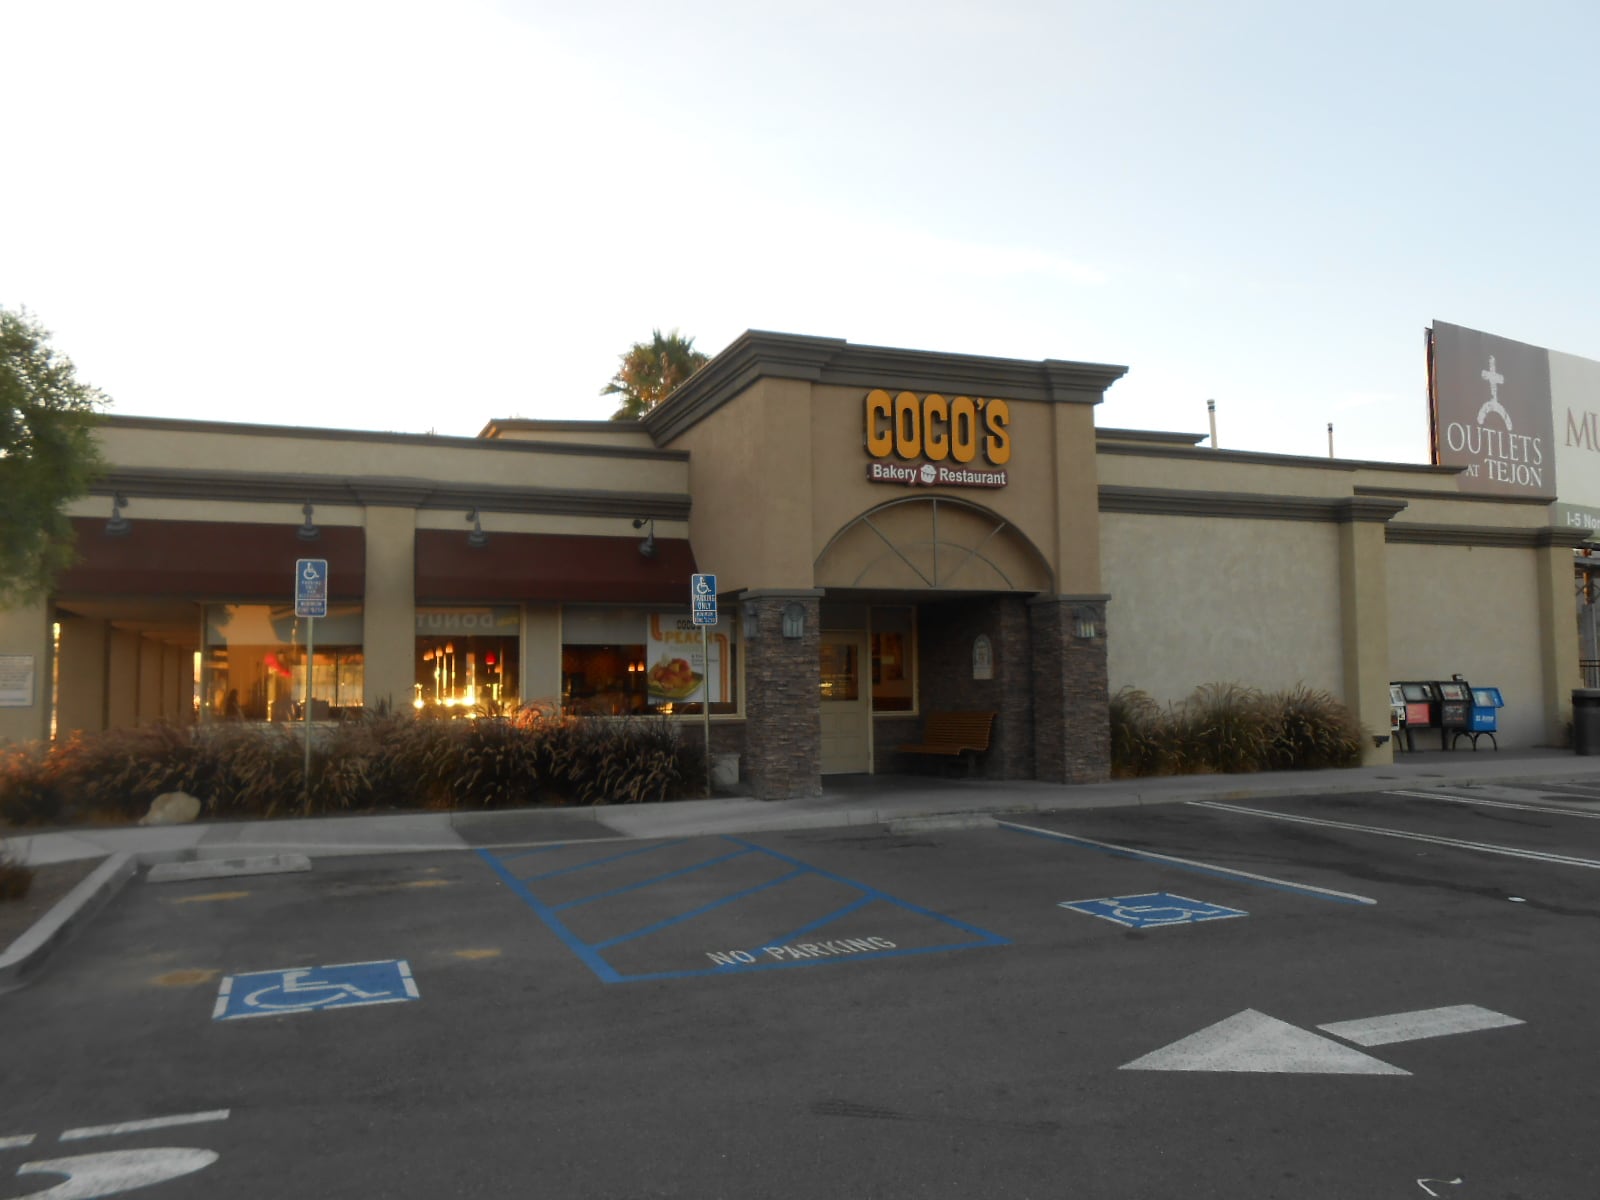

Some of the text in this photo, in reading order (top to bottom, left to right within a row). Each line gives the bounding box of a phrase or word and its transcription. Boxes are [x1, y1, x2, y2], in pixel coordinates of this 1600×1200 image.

[866, 389, 1011, 465] COCO'S
[1447, 422, 1542, 466] OUTLETS
[873, 463, 1006, 485] Bakery Restaurant
[1466, 458, 1543, 488] AT TEJON
[1567, 511, 1581, 528] I-5
[697, 602, 711, 610] ONLY
[706, 936, 897, 966] NO PARKING
